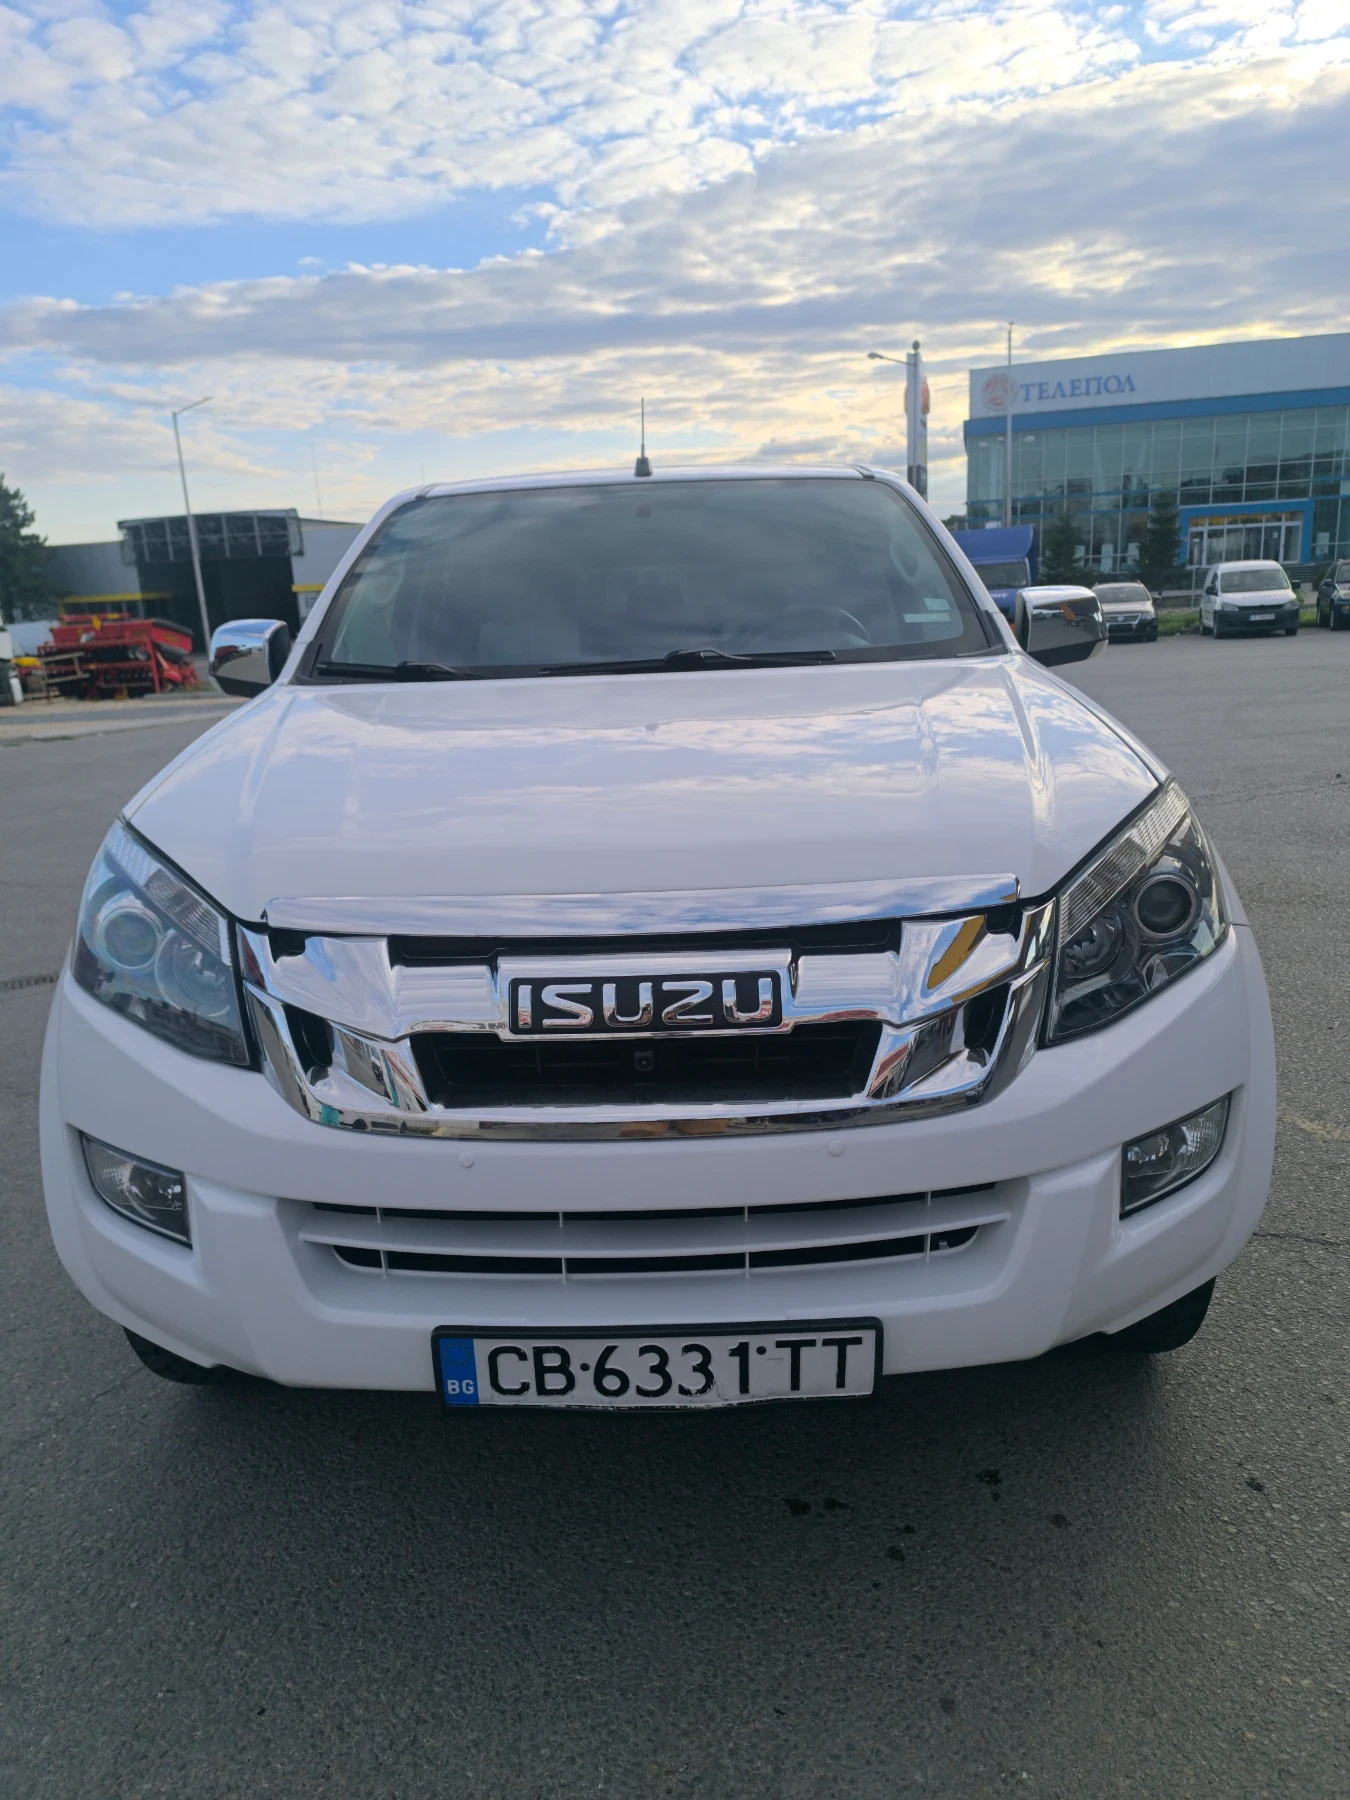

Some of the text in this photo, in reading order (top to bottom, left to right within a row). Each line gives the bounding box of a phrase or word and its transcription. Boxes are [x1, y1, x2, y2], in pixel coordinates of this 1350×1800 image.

[1019, 374, 1137, 402] ТЕЛЕПОЛ
[518, 977, 774, 1029] ISUZU
[447, 1379, 476, 1395] BG
